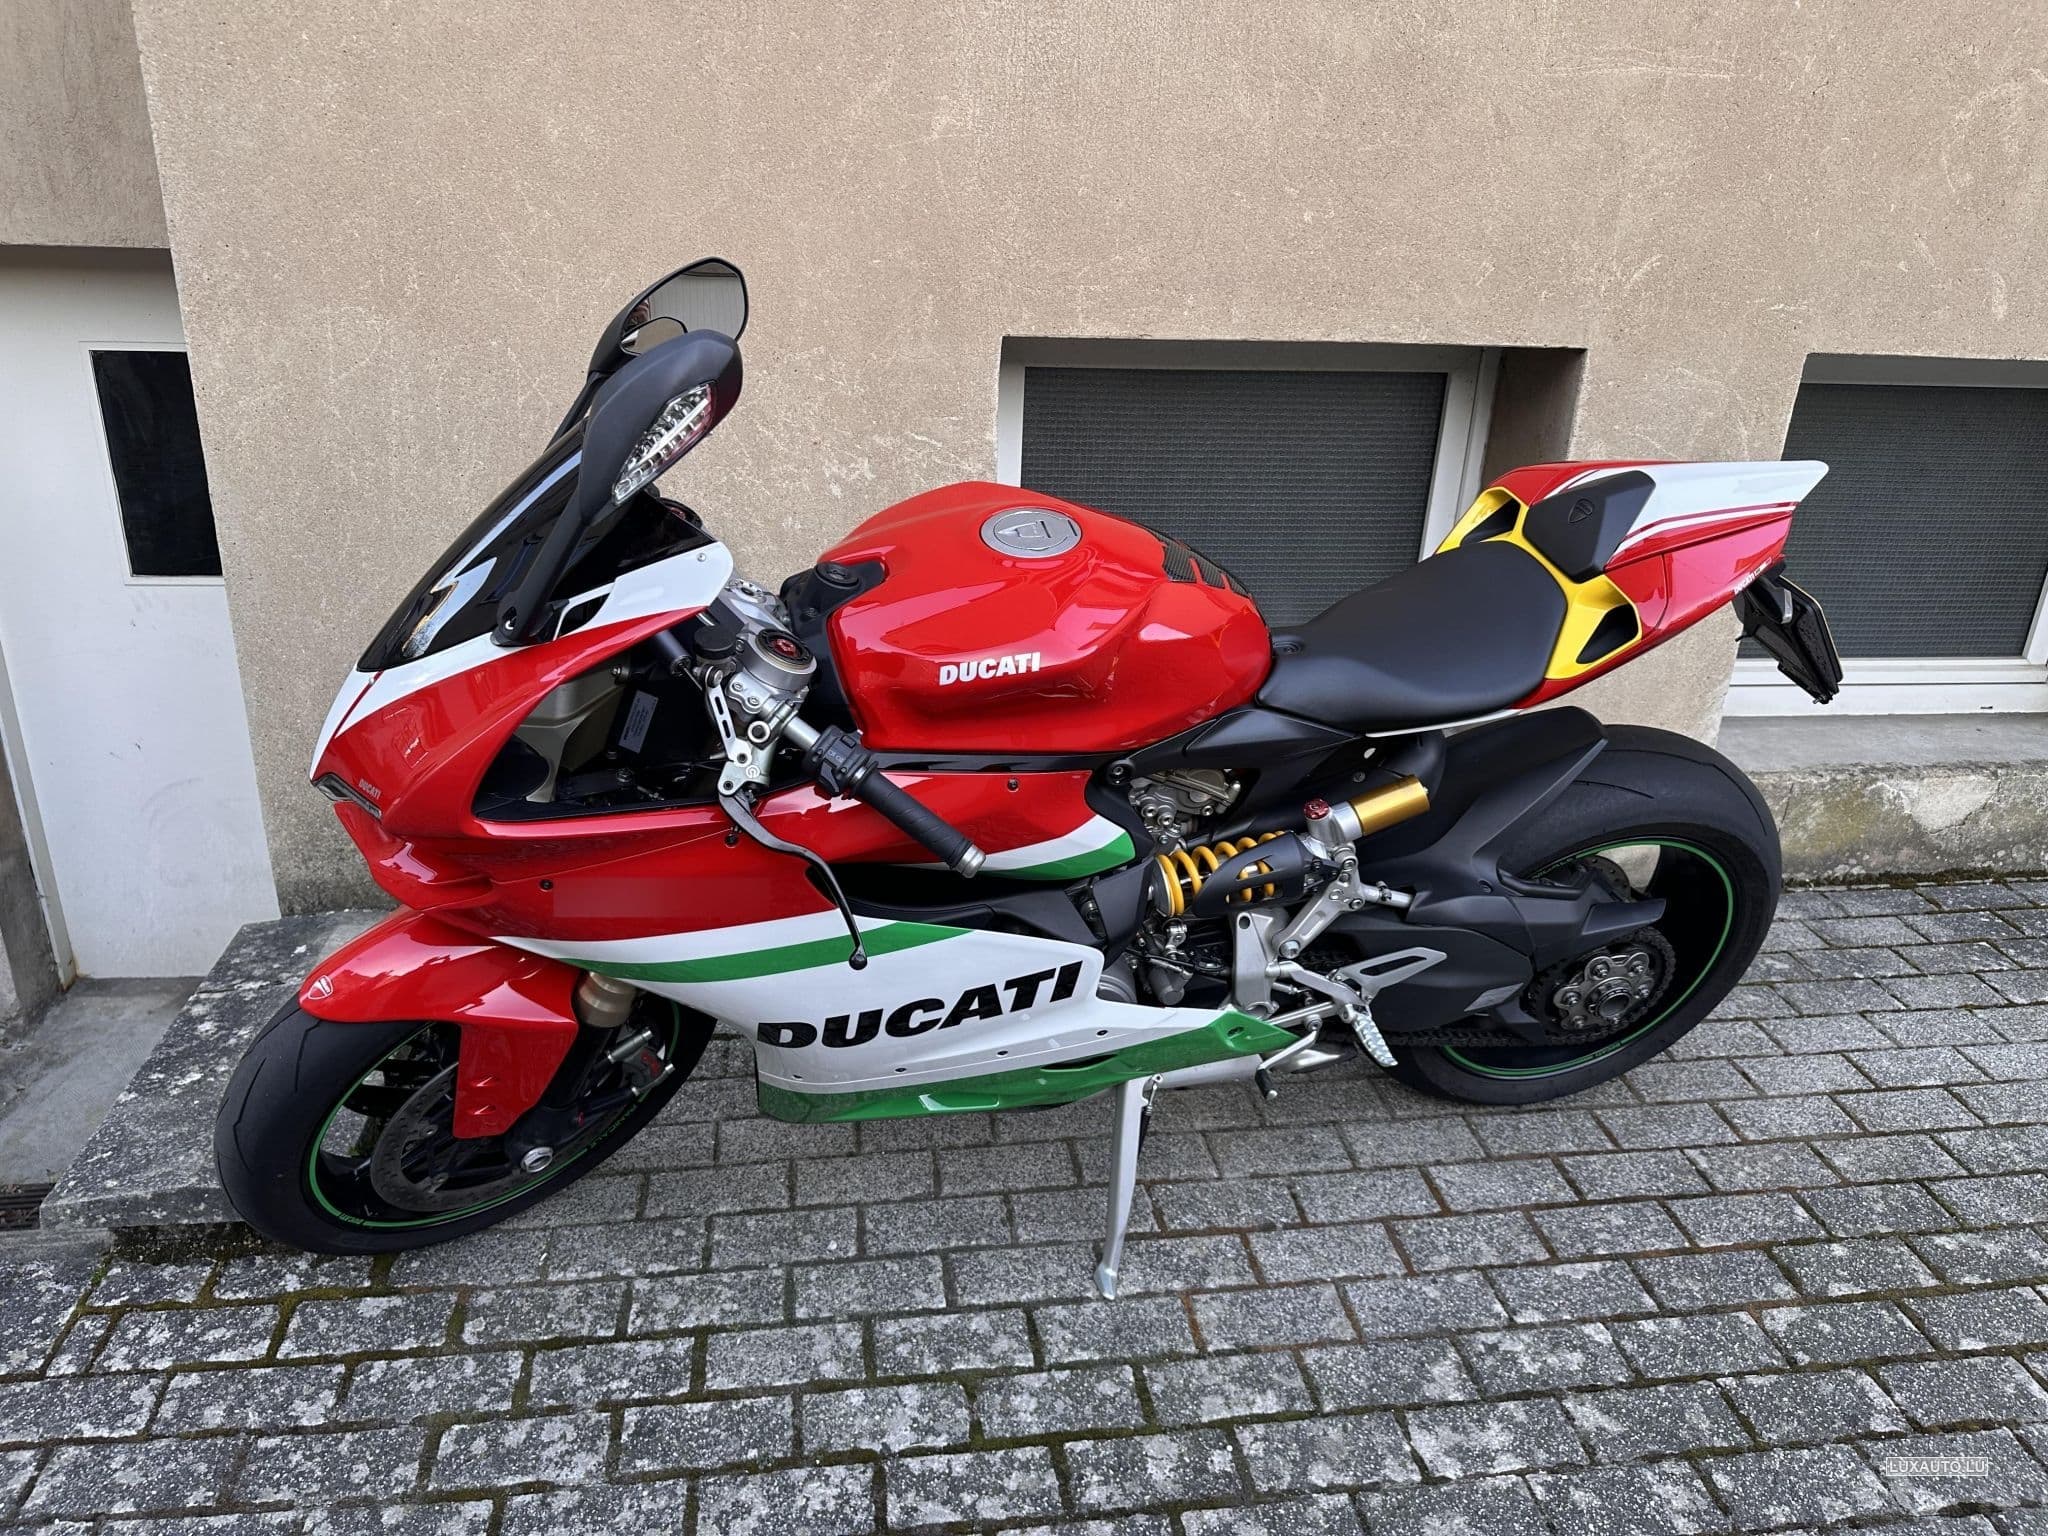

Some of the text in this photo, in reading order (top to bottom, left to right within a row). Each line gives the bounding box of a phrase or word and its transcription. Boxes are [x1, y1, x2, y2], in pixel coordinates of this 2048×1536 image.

[939, 652, 1040, 685] DUCATI
[359, 779, 381, 799] DUCATI
[757, 960, 1083, 1048] DUCATI
